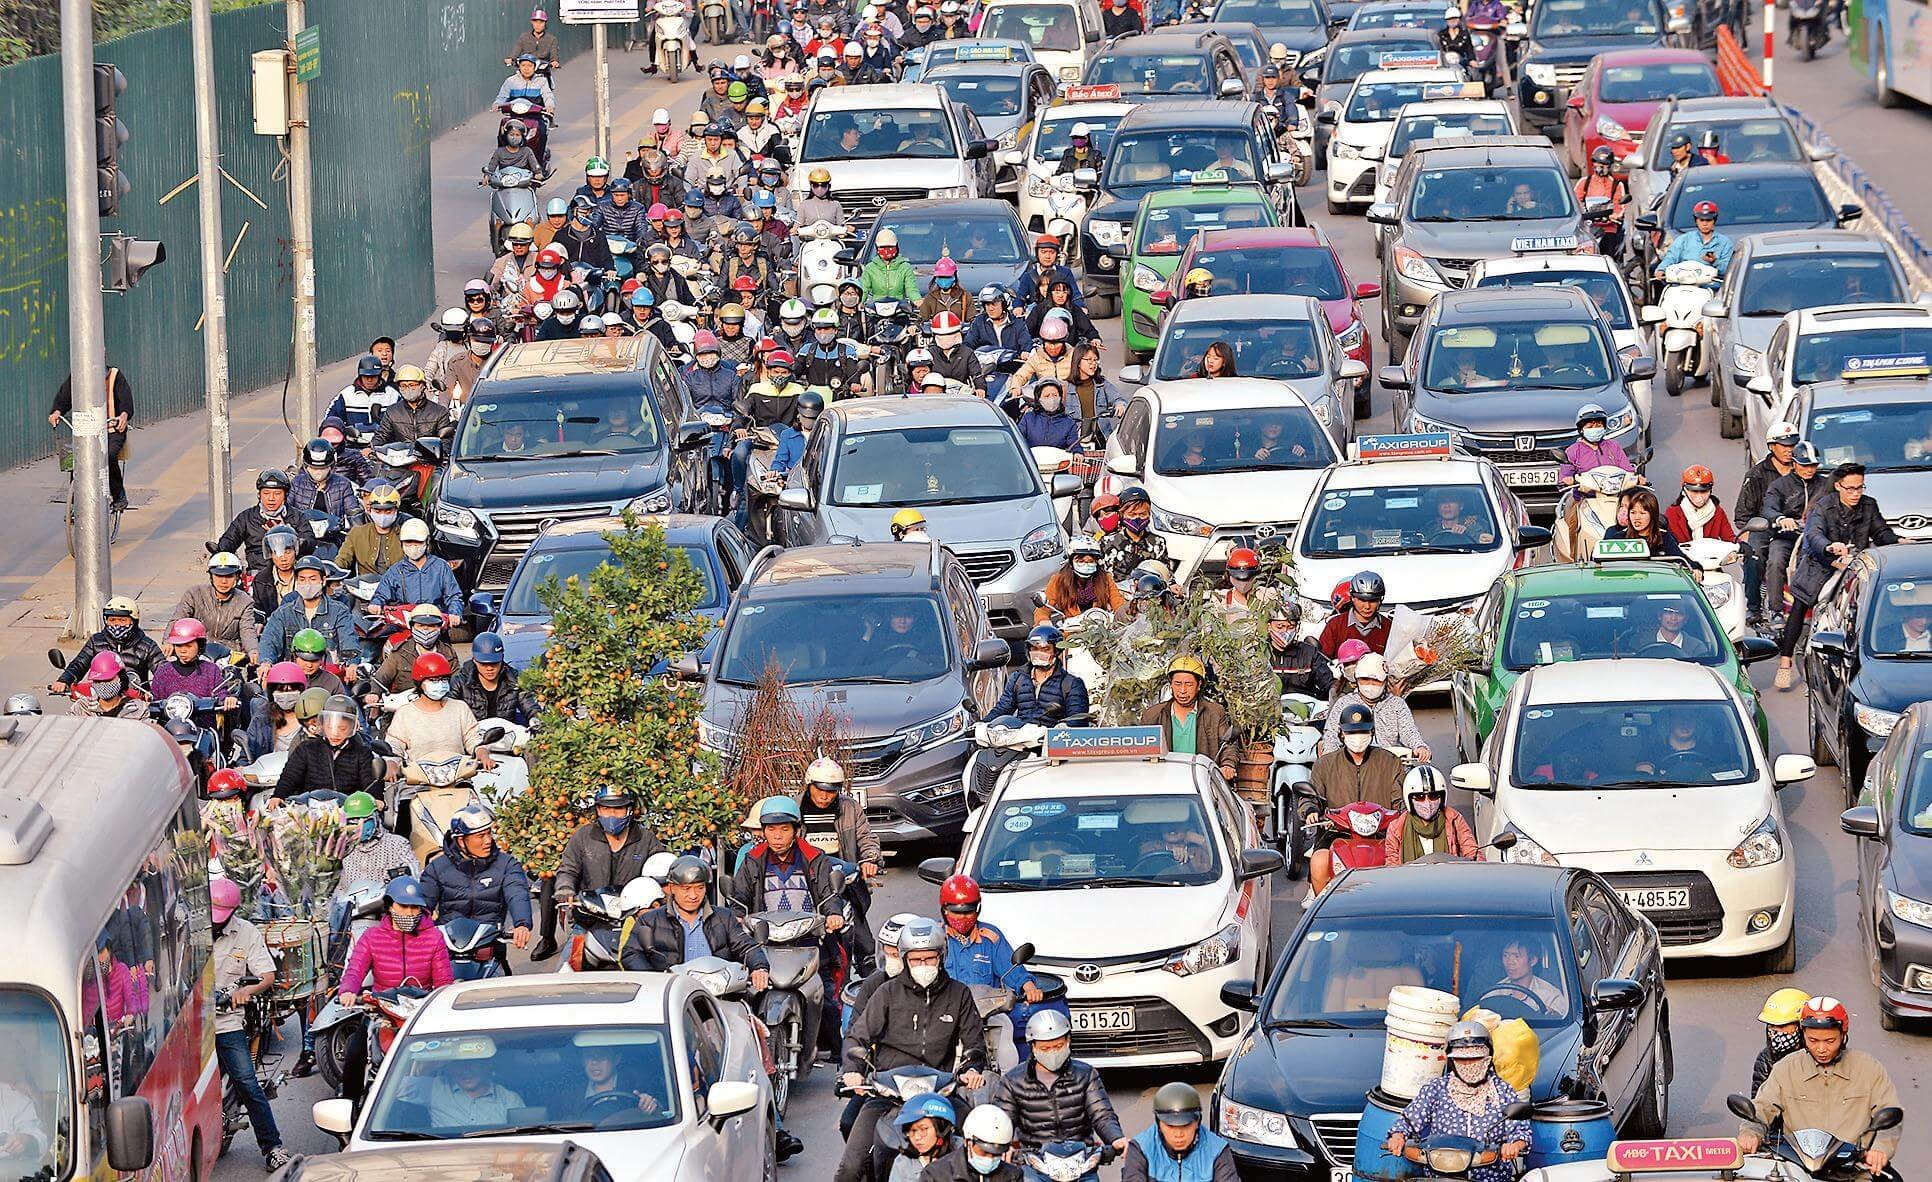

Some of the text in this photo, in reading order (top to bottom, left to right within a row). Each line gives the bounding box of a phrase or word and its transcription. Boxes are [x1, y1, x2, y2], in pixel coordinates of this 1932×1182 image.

[1371, 439, 1448, 450] TAXIGROUP
[1600, 542, 1643, 553] TAXI
[1062, 736, 1157, 748] TAXIGROUP
[1617, 890, 1687, 908] A-485.52
[1650, 1145, 1703, 1161] TAXI
[1705, 1147, 1731, 1155] METER
